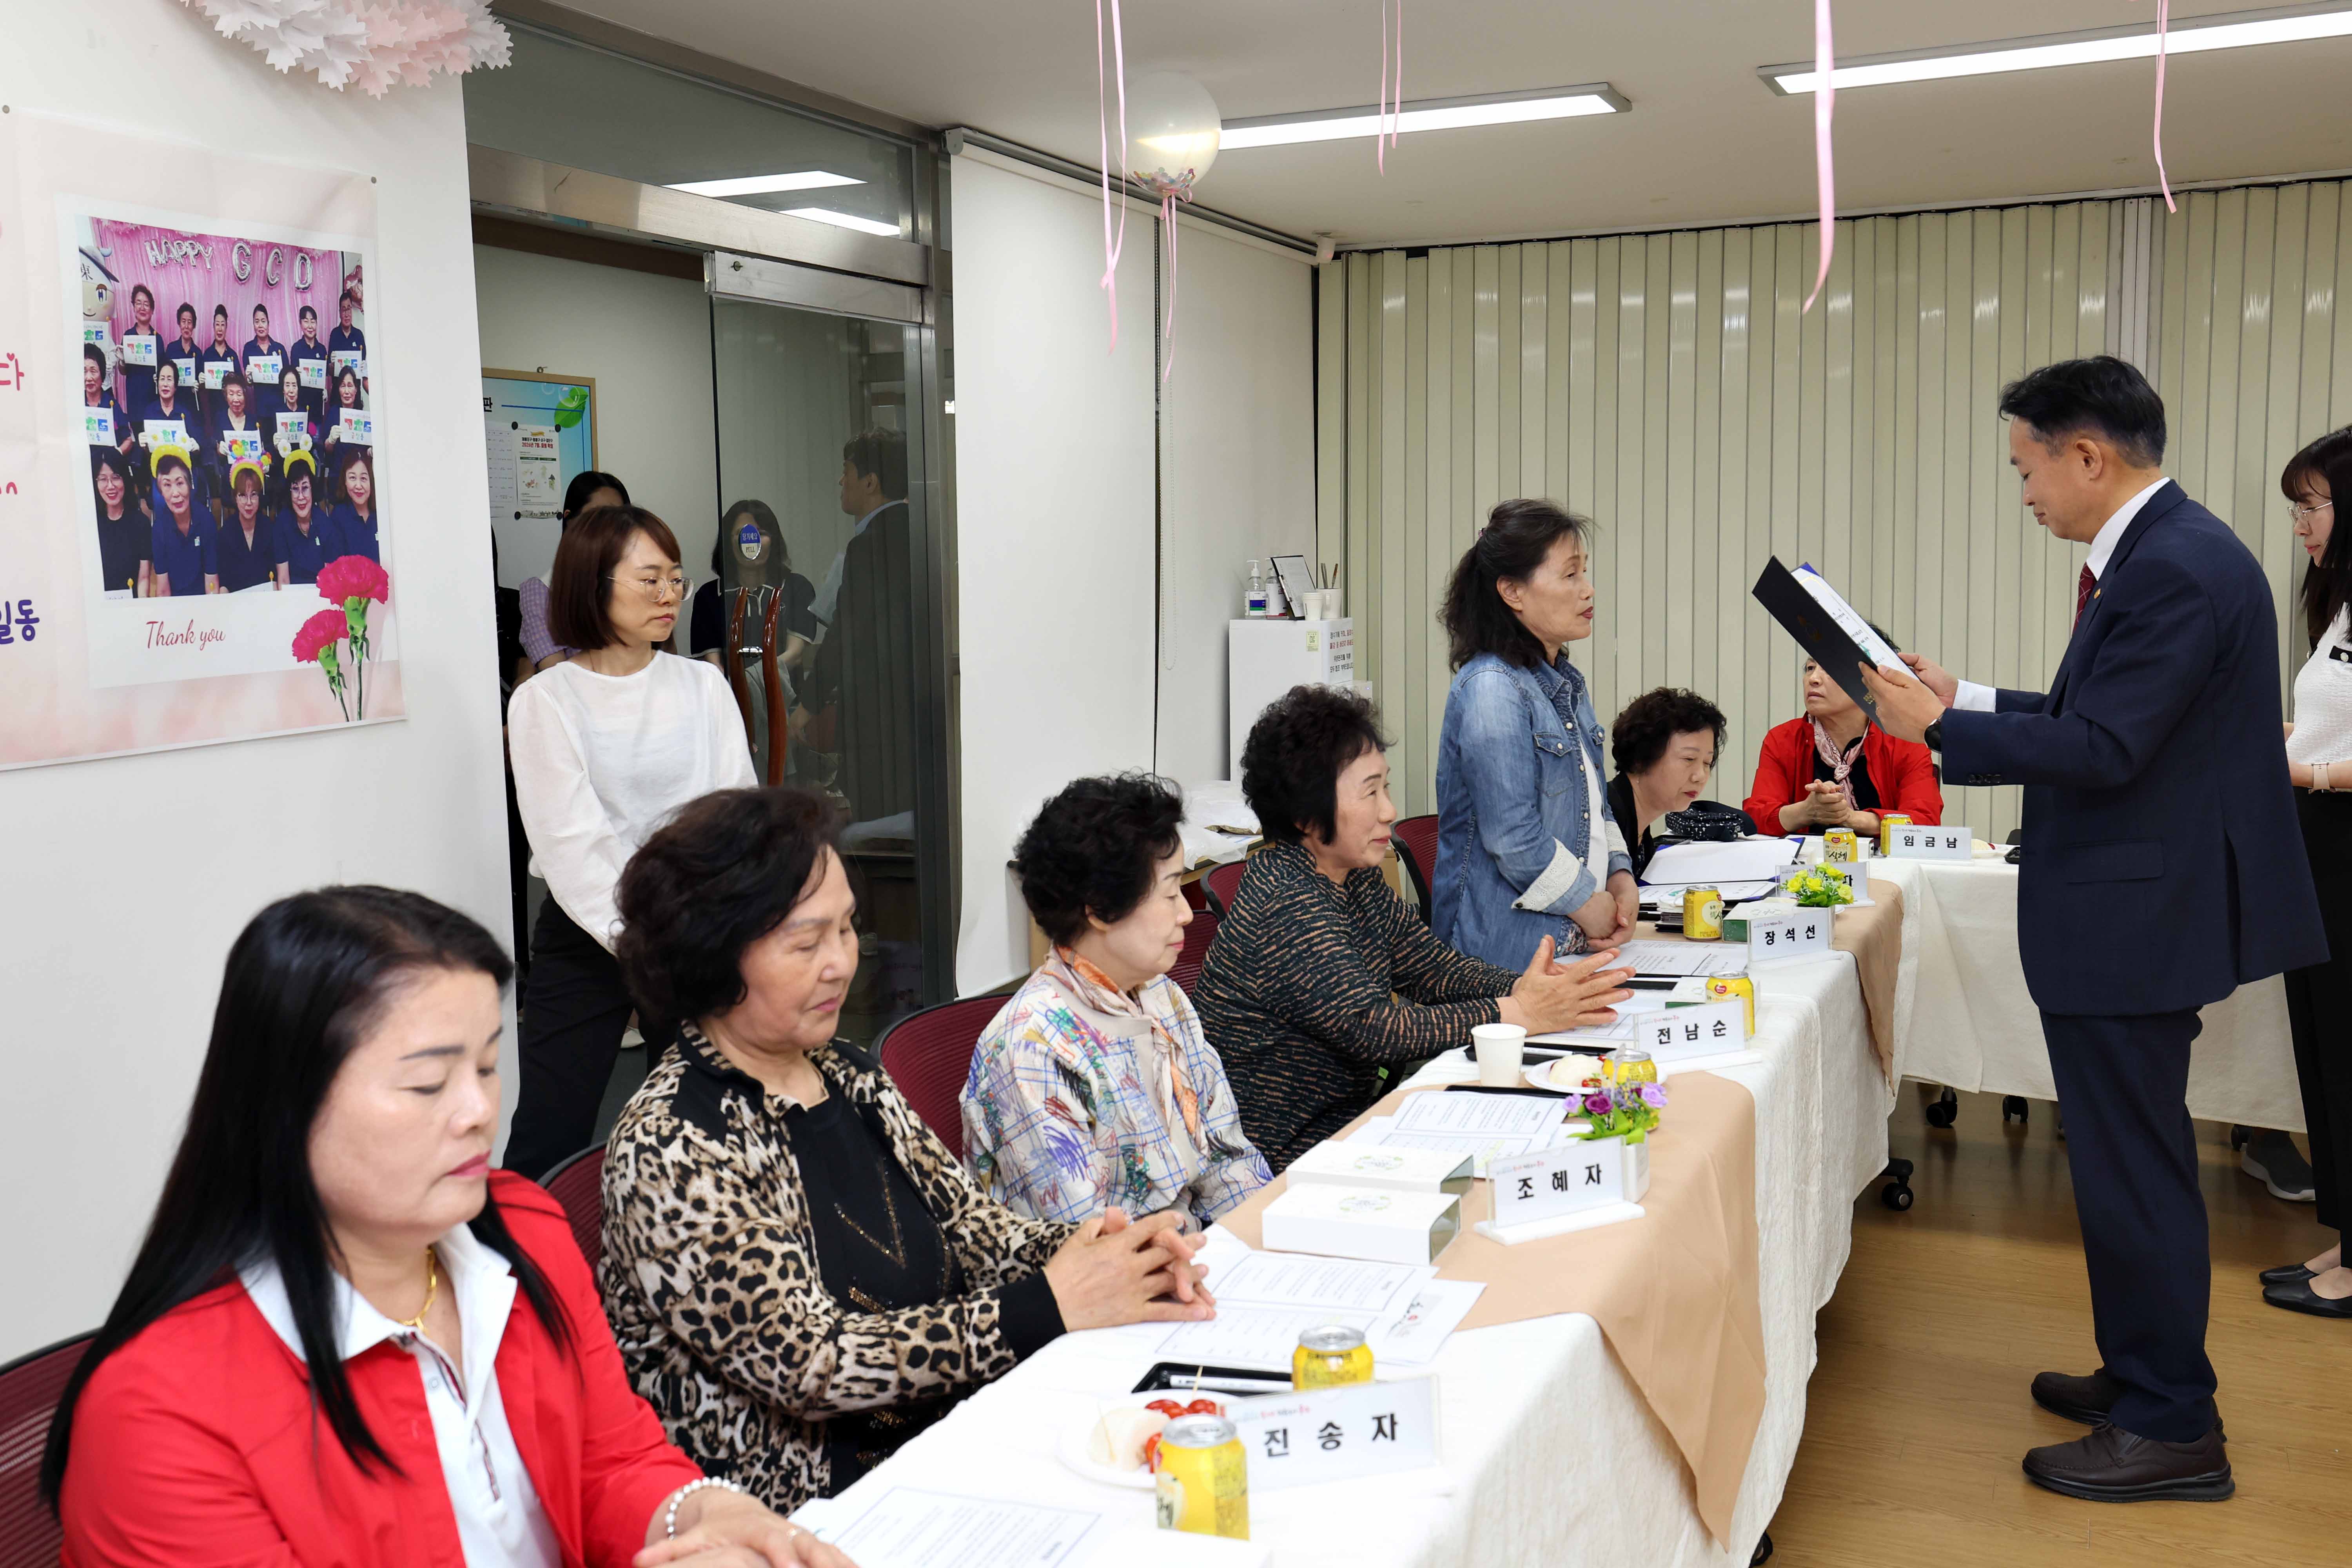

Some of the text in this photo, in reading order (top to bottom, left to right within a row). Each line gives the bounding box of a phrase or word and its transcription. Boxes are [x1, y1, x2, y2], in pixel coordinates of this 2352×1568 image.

[145, 239, 213, 270] HAPPY
[146, 619, 226, 651] Thank you
[1828, 851, 1847, 862] 식혜
